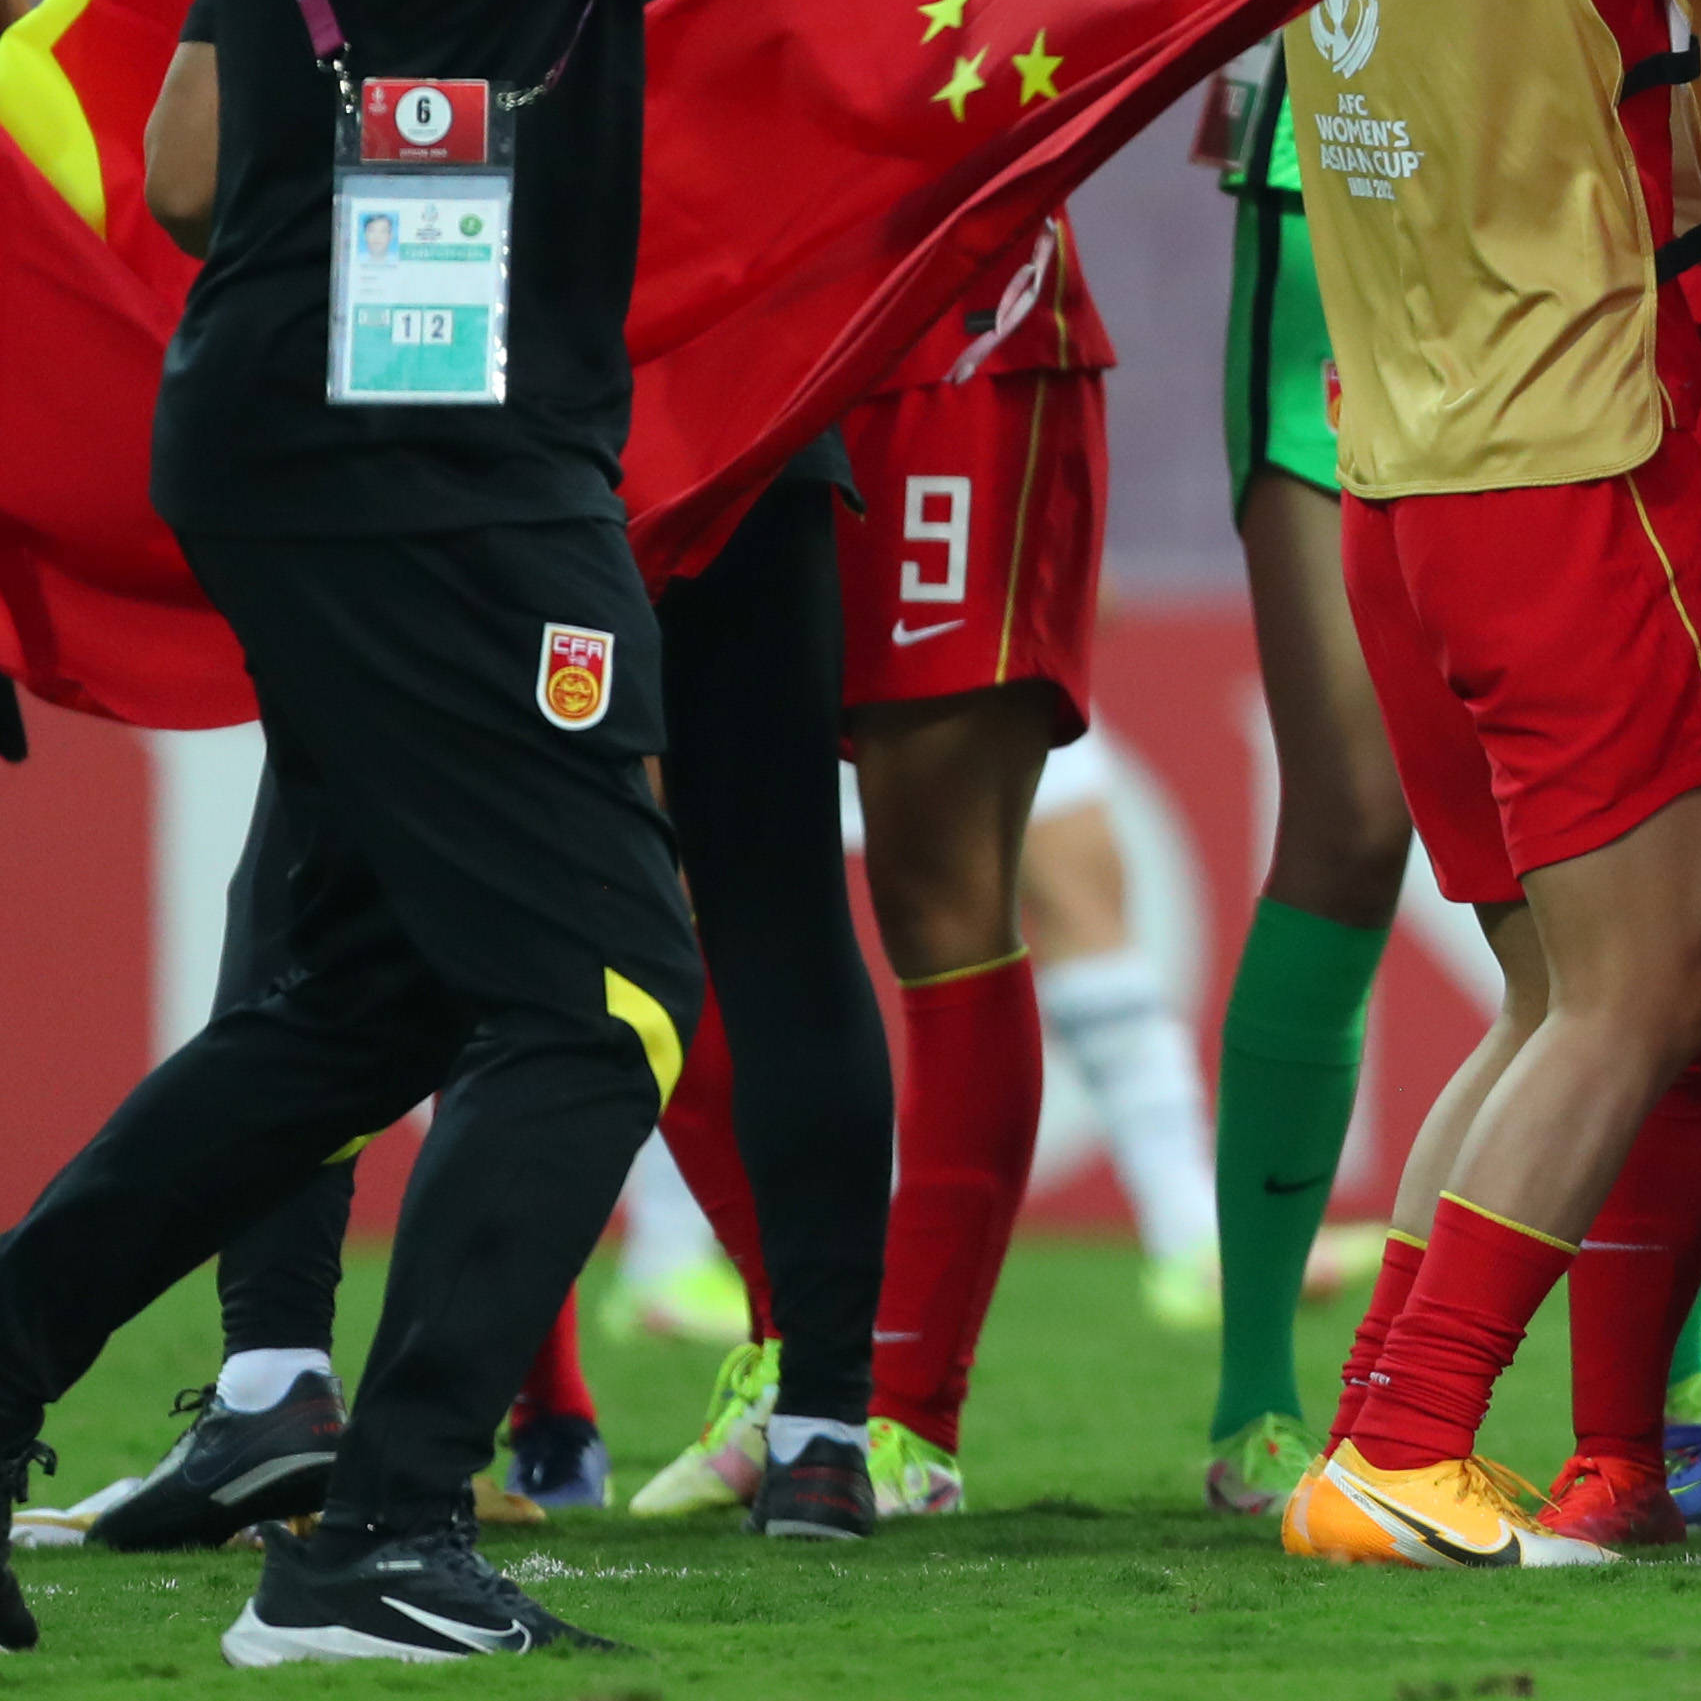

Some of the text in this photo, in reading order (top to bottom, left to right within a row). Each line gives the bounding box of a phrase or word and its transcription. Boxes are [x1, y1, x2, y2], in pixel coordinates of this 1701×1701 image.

[416, 96, 431, 125] 6
[1337, 93, 1368, 117] AFC
[1314, 113, 1411, 149] WOMEN'S
[1320, 142, 1420, 179] ASIAN CUP
[900, 474, 972, 604] 9
[553, 635, 604, 661] CFA
